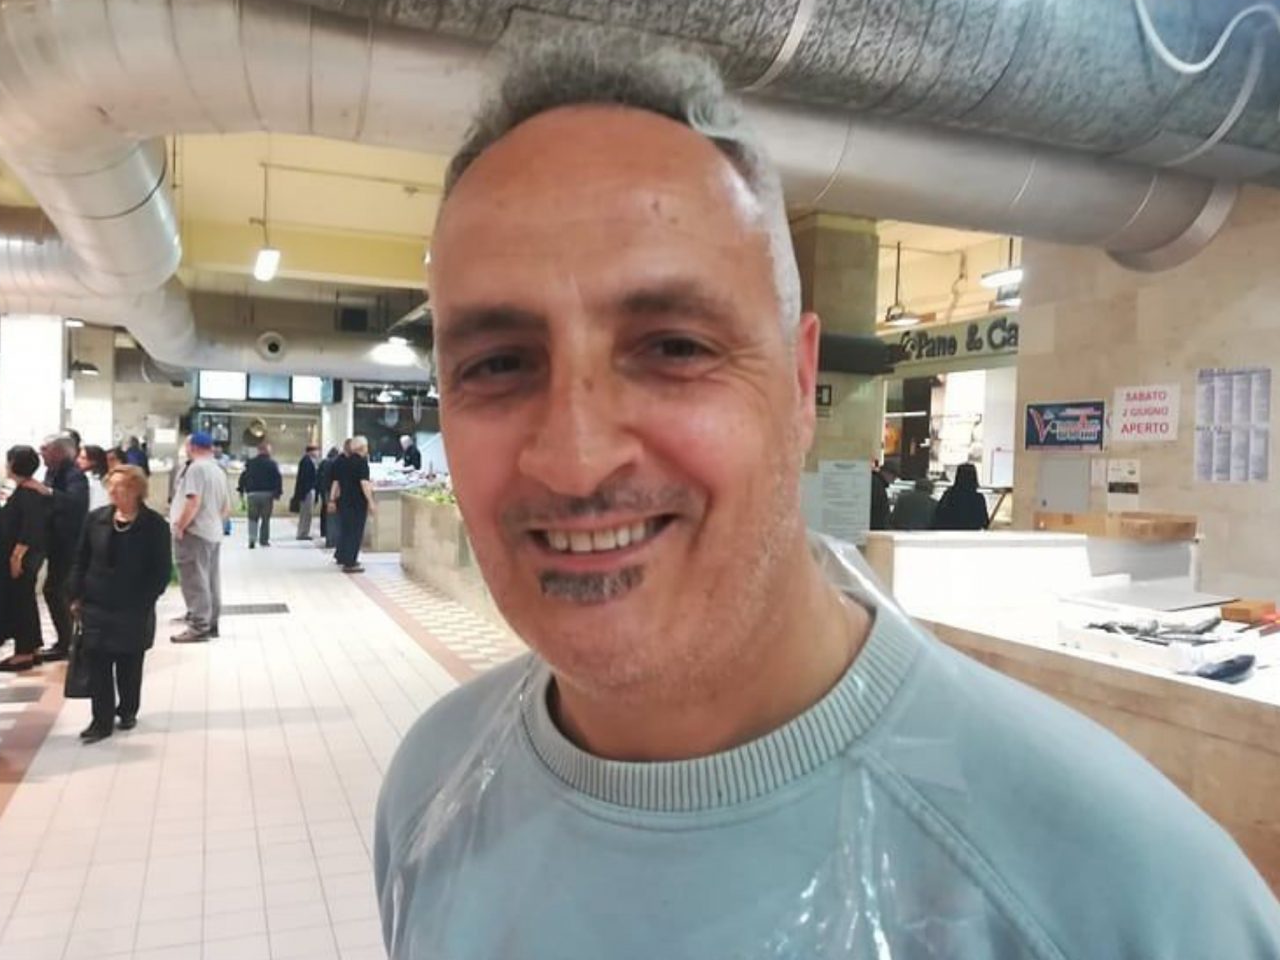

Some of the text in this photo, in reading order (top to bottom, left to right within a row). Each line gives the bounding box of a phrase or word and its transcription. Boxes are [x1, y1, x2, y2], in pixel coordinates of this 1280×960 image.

[1125, 390, 1167, 401] SABATO
[1130, 407, 1169, 417] GIUGNO
[1121, 422, 1169, 434] APERTO
